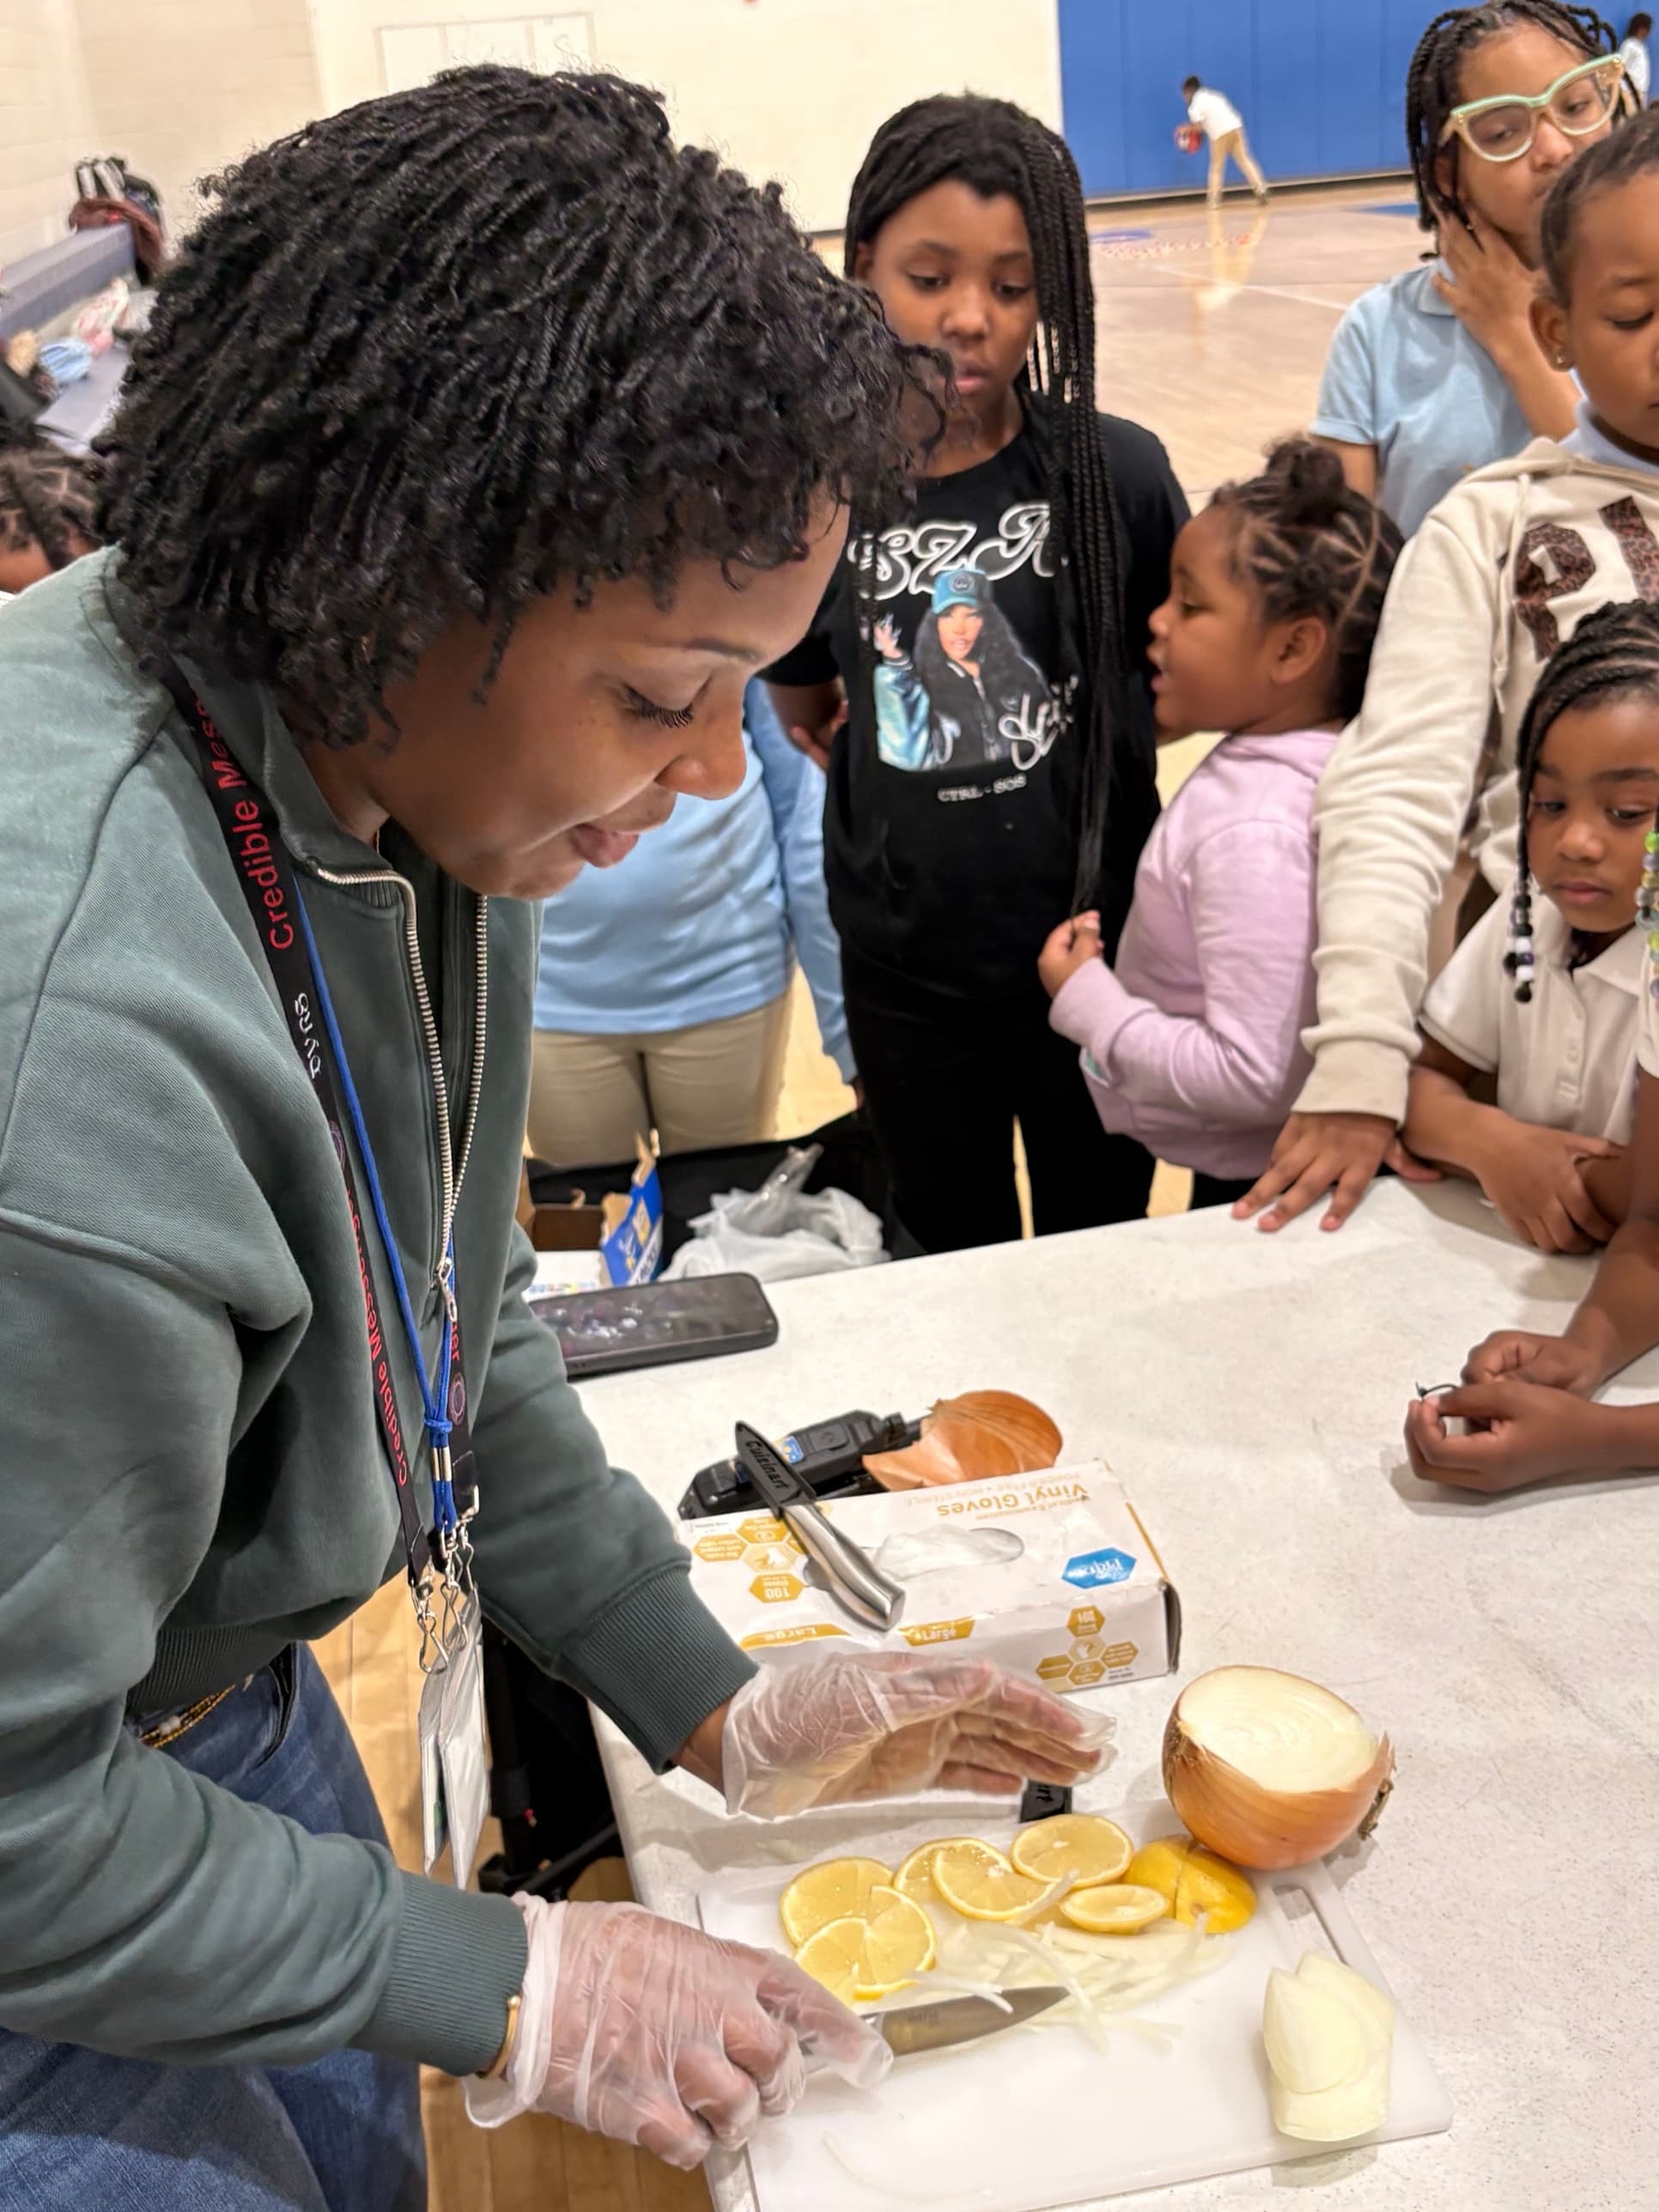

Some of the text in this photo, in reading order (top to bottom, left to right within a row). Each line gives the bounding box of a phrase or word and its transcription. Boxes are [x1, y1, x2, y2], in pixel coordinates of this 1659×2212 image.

[233, 798, 295, 950] Credible
[378, 1360, 408, 1486] Credible
[745, 1442, 790, 1488] Cuisinart
[937, 1482, 1089, 1516] Vinyl Gloves
[764, 1587, 790, 1599] 100
[764, 1627, 817, 1641] Large
